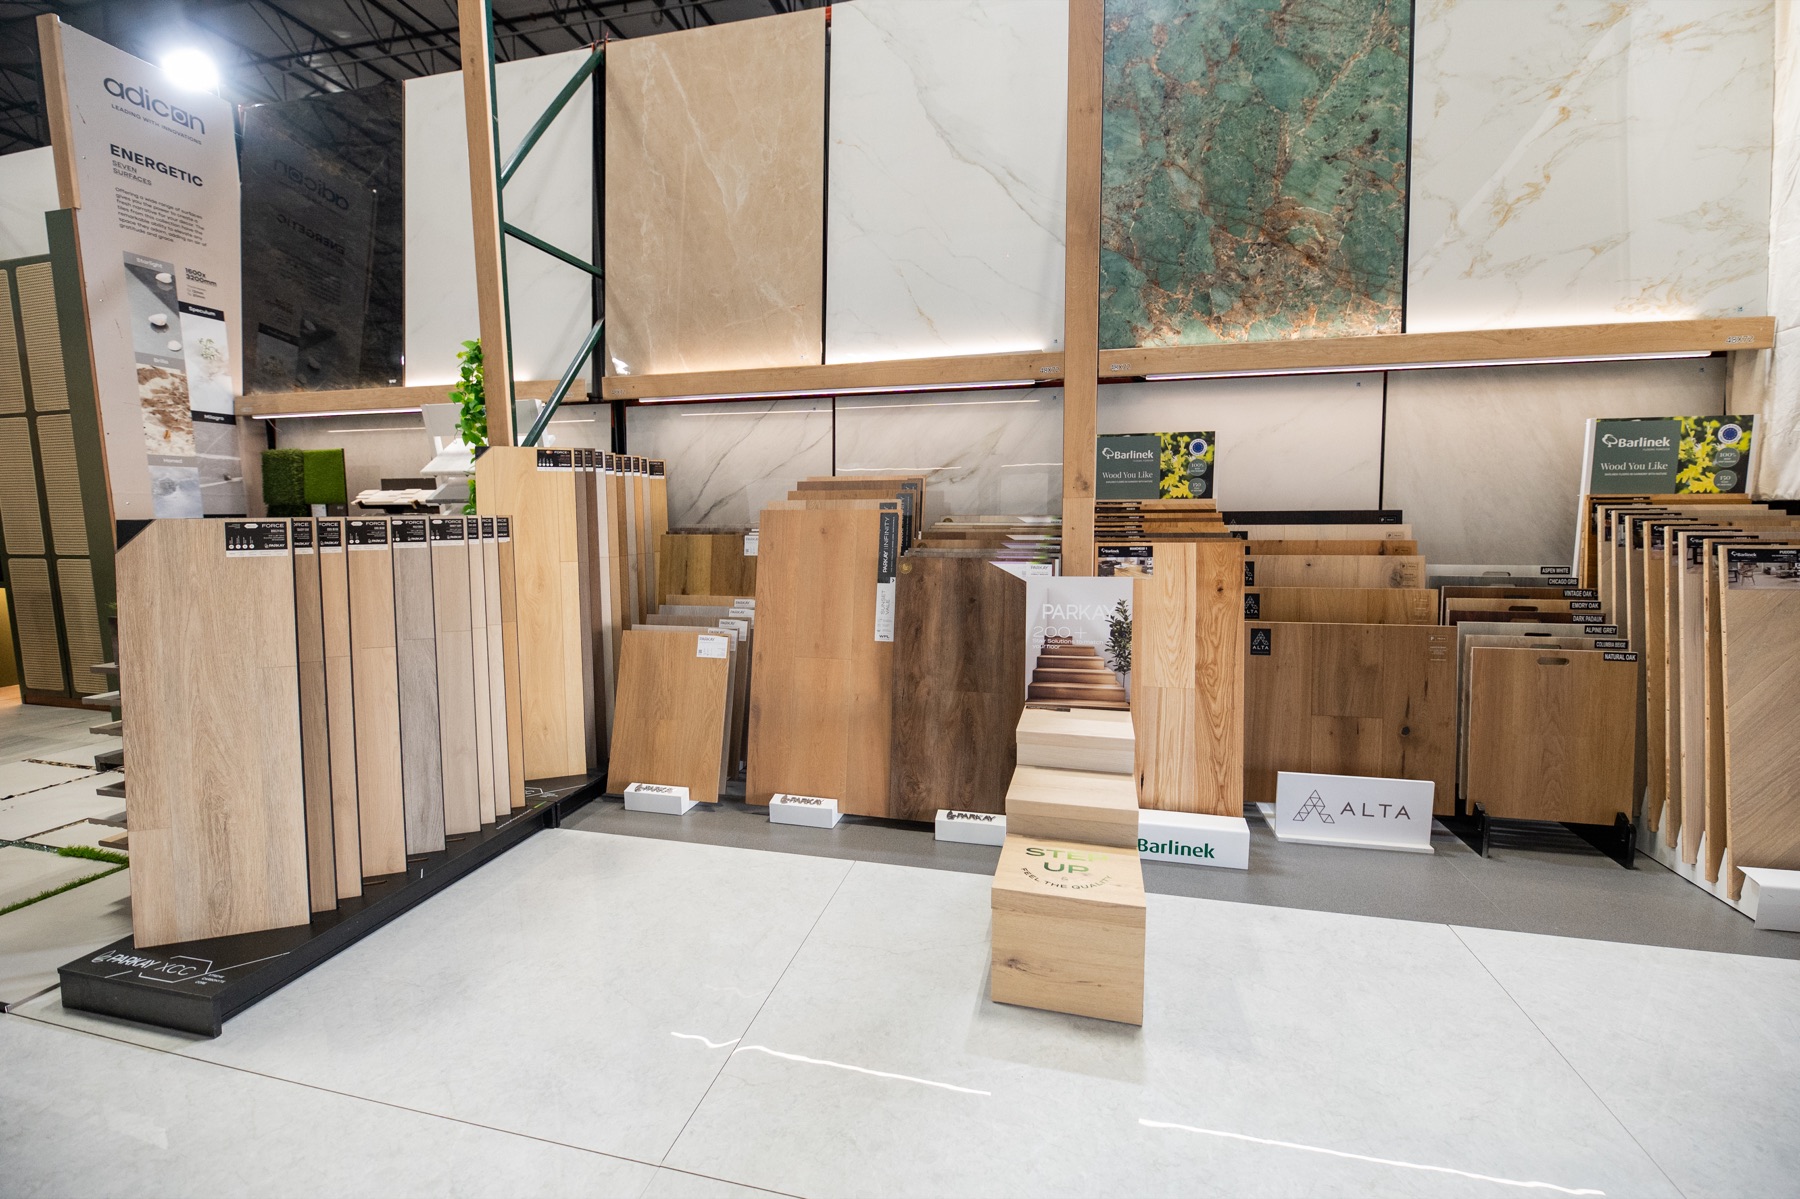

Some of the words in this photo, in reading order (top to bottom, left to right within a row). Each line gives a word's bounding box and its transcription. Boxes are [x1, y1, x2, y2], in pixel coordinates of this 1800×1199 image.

[103, 77, 206, 135] adicon
[111, 104, 141, 120] LEADING
[143, 116, 161, 127] WITH
[161, 125, 202, 145] INNOVATIONS
[110, 143, 203, 187] ENERGETIC
[112, 160, 137, 174] SEVEN
[113, 167, 152, 186] SURFACES
[184, 267, 206, 279] 1600x
[185, 273, 217, 287] 3200mm
[1618, 436, 1671, 448] Barlinek
[1114, 449, 1154, 460] Barlinek
[1600, 462, 1627, 471] Wood
[1628, 462, 1646, 471] You
[1647, 461, 1669, 470] Like
[1102, 471, 1122, 479] Wood
[1123, 471, 1137, 479] You
[1138, 470, 1154, 479] Like
[1042, 603, 1115, 620] PARKAY
[1032, 625, 1071, 638] 200
[1074, 626, 1088, 639] +
[789, 796, 824, 806] PARKAY
[956, 812, 996, 822] PARKAY
[1340, 801, 1411, 820] ALTA
[1025, 847, 1109, 862] STEP
[1138, 838, 1215, 859] Barlinek
[1043, 862, 1089, 874] UP
[1020, 866, 1041, 883] FEEL
[1044, 880, 1068, 889] THE
[1071, 875, 1112, 890] QUALITY
[107, 953, 159, 969] PARKAY
[155, 962, 197, 976] XCC
